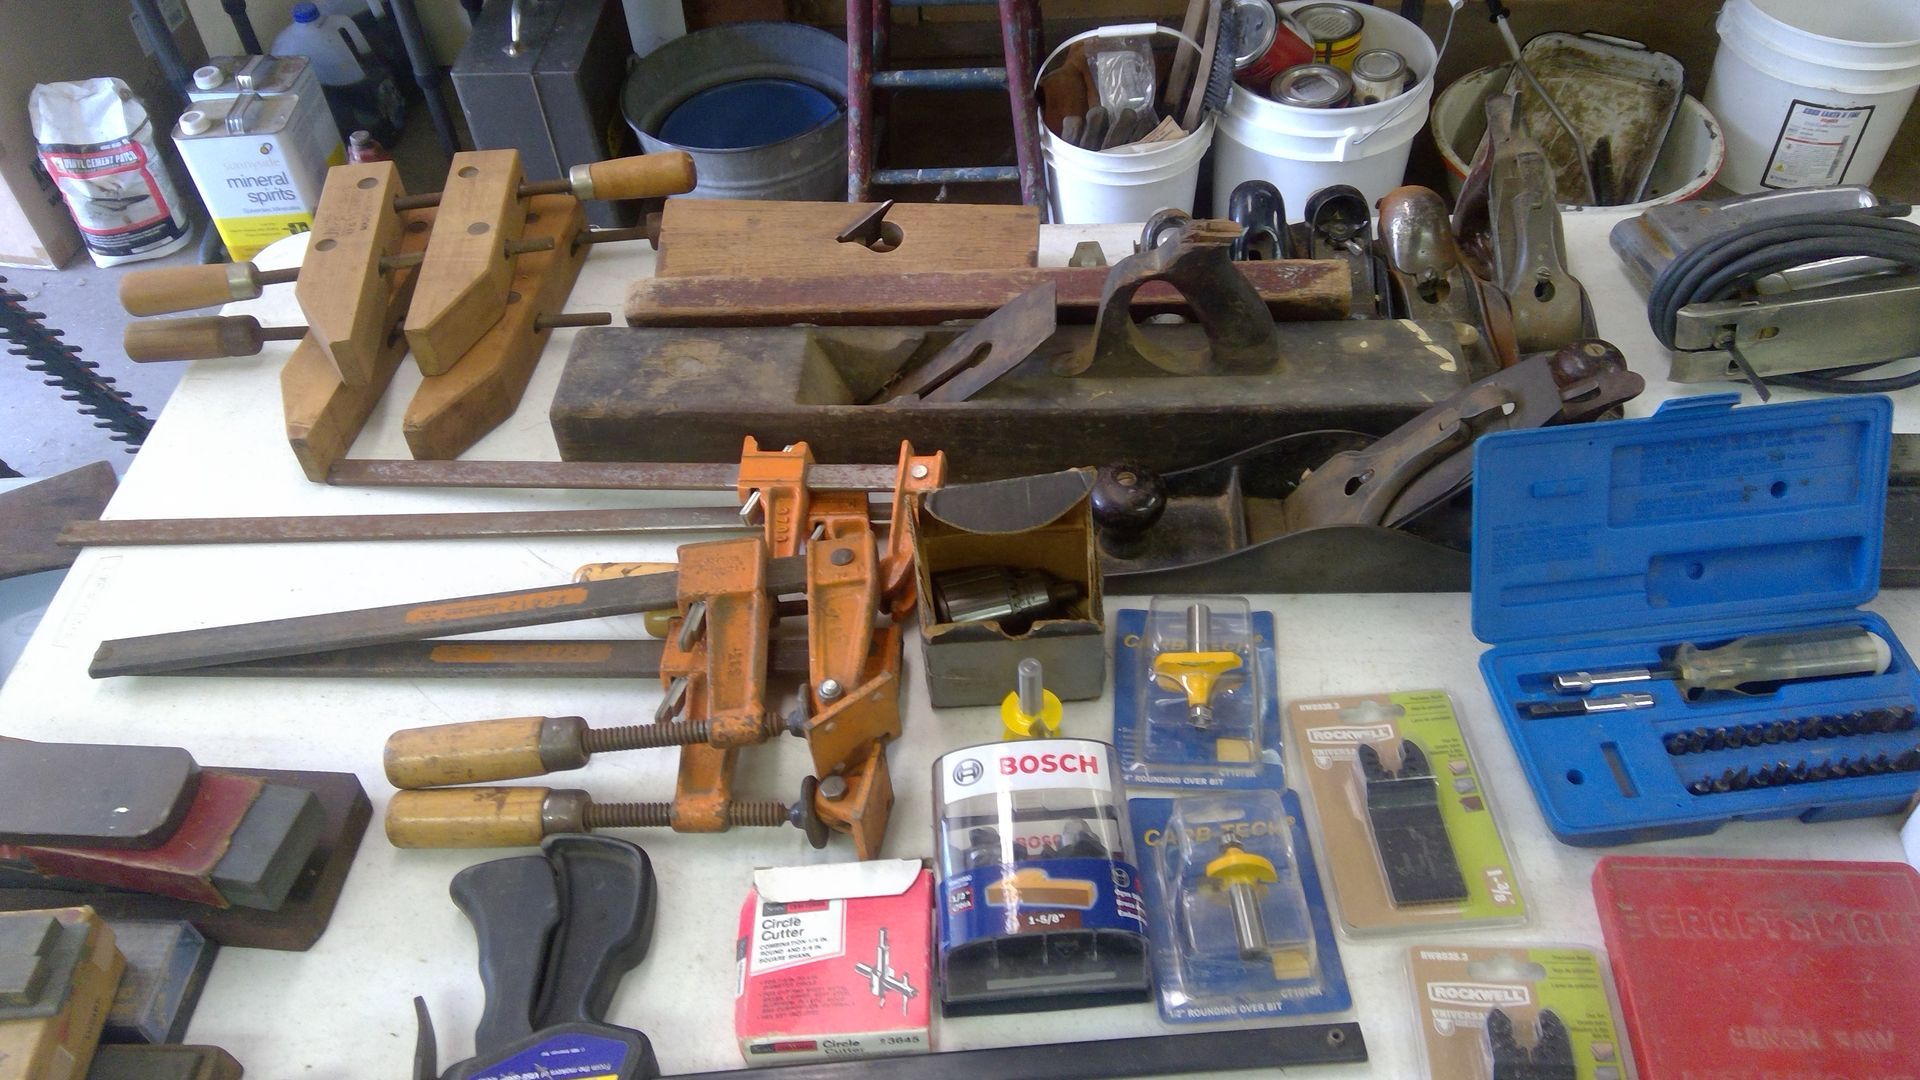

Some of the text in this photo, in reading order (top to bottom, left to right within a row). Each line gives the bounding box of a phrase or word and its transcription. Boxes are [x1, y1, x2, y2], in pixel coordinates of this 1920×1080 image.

[86, 155, 114, 168] CEMENT
[115, 151, 138, 163] PATCH
[226, 172, 289, 189] mineral
[248, 188, 297, 205] spirits
[1311, 728, 1389, 741] ROCKWELL
[1000, 753, 1099, 776] BOSCH
[1135, 775, 1181, 784] ROUNDING
[1183, 776, 1207, 785] OVER
[1209, 778, 1225, 786] BIT
[762, 917, 802, 930] Circle
[761, 928, 805, 941] Cutter
[1434, 986, 1525, 1001] ROCKWELL
[1188, 1004, 1238, 1018] ROUNDING
[1239, 1003, 1265, 1014] OVER
[1267, 1001, 1283, 1012] BIT
[1431, 1007, 1486, 1020] UNIVERSA
[823, 1039, 861, 1049] Circle
